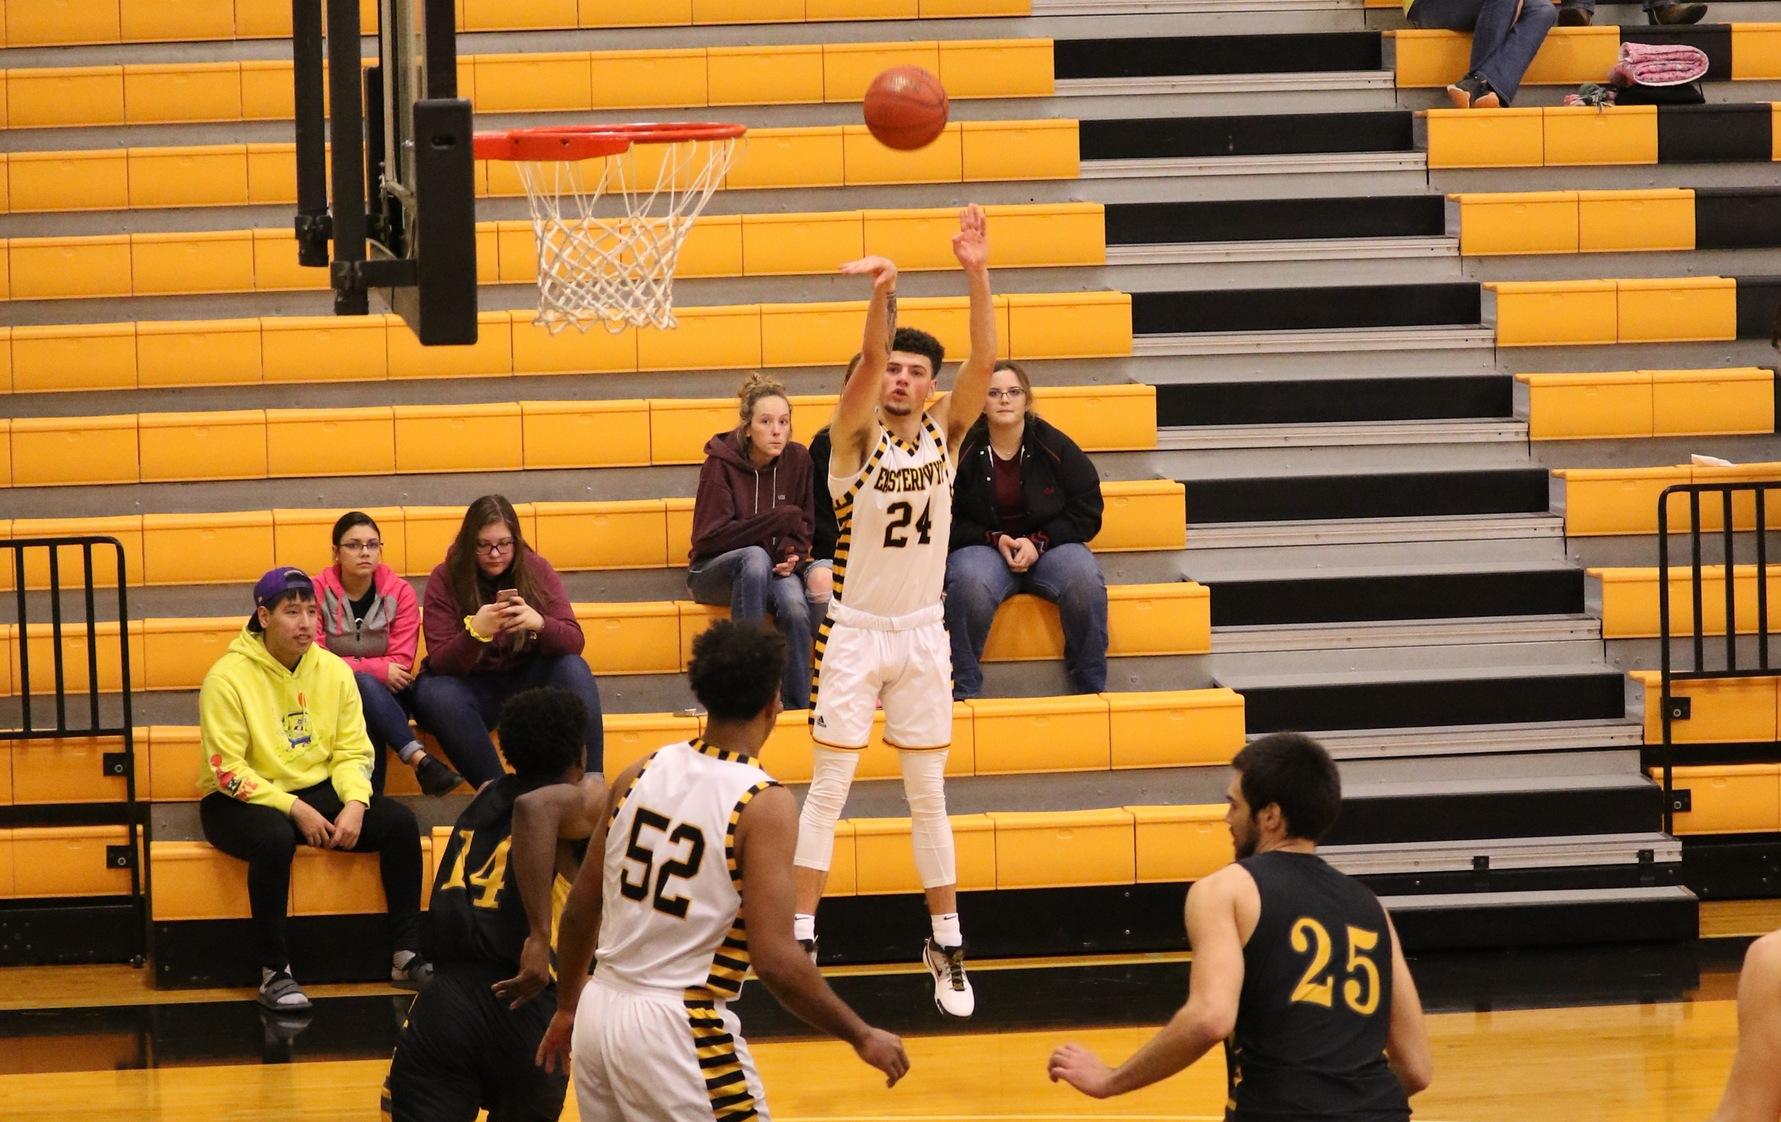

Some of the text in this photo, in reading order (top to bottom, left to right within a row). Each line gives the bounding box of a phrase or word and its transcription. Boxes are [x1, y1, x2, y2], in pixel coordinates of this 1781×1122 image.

[883, 496, 931, 548] 24
[441, 829, 512, 909] 14
[620, 807, 705, 919] 52
[1291, 916, 1380, 1015] 25
